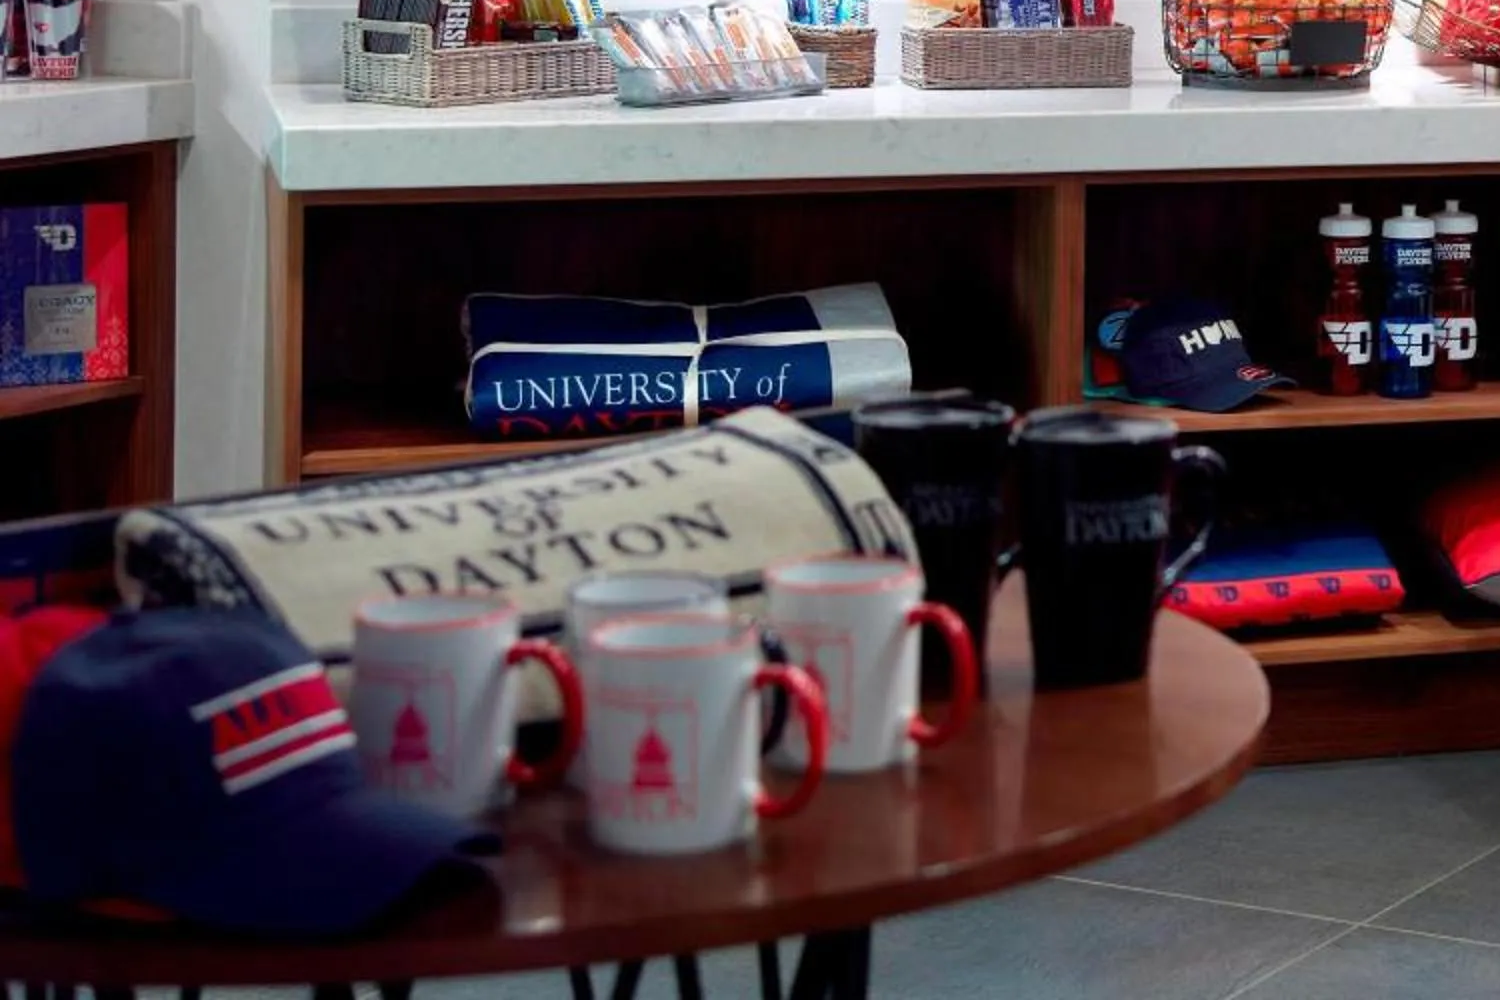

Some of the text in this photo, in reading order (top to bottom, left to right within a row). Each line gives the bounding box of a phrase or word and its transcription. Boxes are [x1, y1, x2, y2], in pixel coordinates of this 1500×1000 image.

[493, 363, 792, 412] UNIVERSITY of
[253, 444, 733, 545] UNIVERSITY
[377, 500, 734, 597] DAYTON
